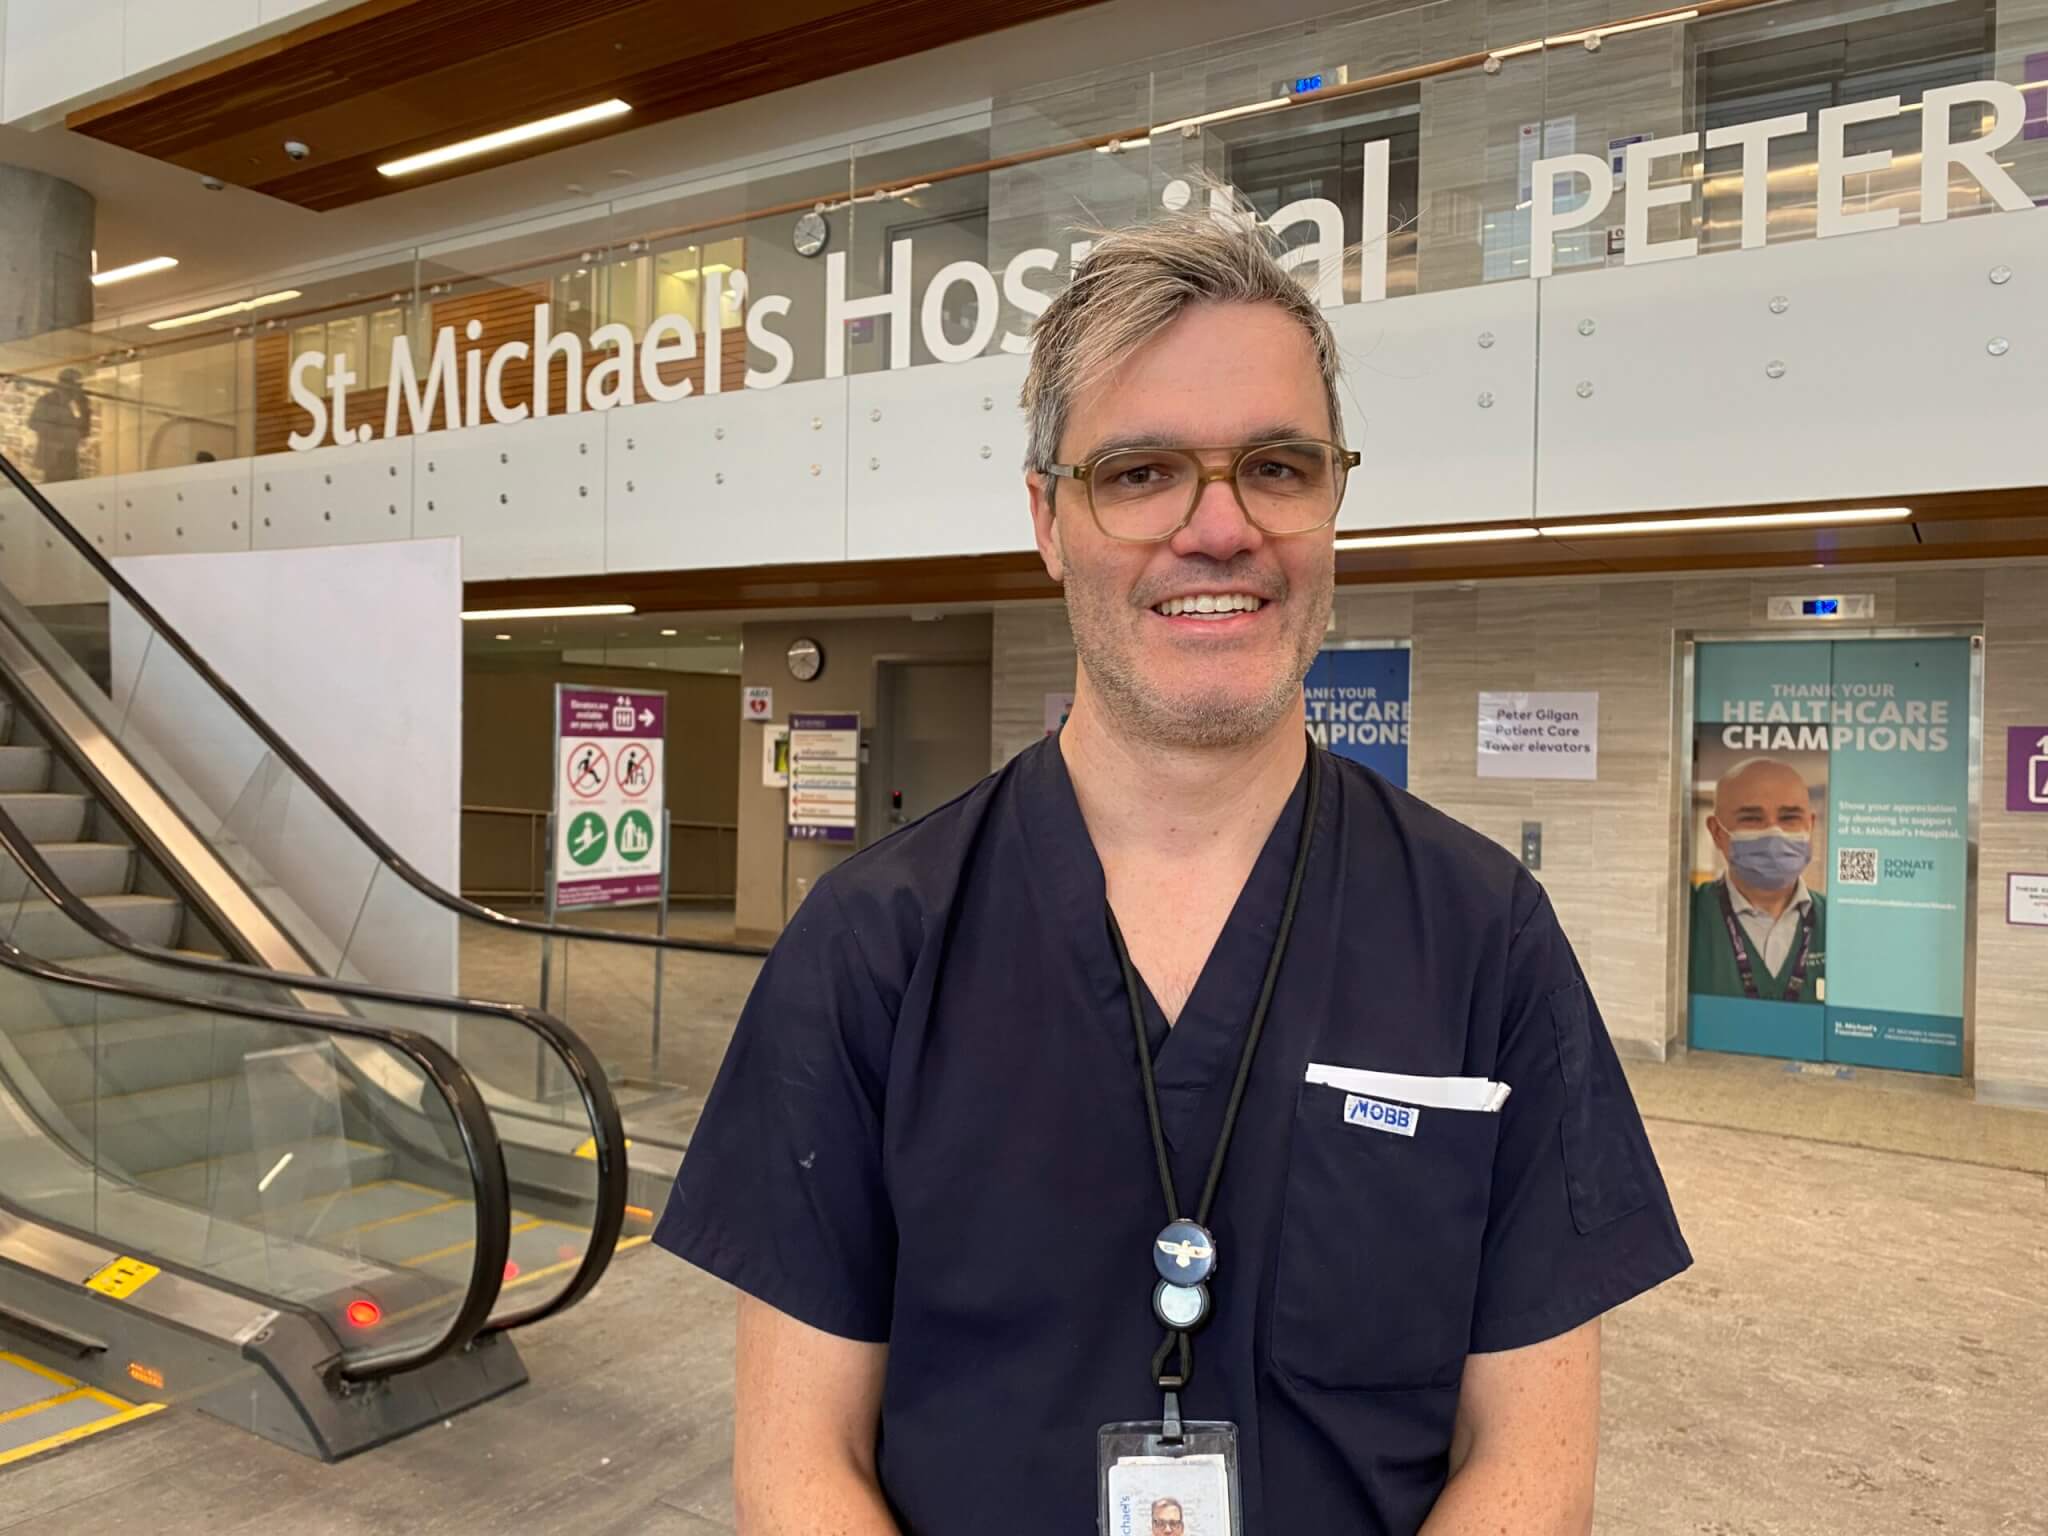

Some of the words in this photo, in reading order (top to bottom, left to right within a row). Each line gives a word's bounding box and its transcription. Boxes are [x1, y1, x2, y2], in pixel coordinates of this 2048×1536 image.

[288, 350, 371, 451] St.
[383, 269, 795, 438] Michael's
[825, 138, 1390, 379] Hosal
[1530, 80, 2036, 279] PETER
[1304, 687, 1335, 699] ANK
[1338, 687, 1377, 699] YOUR
[1771, 684, 1836, 697] THANK
[1841, 683, 1895, 698] YOUR
[1304, 701, 1410, 722] THCARE
[1496, 709, 1533, 721] Peter
[1536, 708, 1579, 723] Gilgan
[1722, 700, 1949, 724] HEALTHCARE
[1305, 723, 1410, 745] MPIONS
[1495, 724, 1545, 737] Patient
[1547, 725, 1580, 737] Care
[1722, 725, 1949, 752] CHAMPIONS
[1484, 740, 1525, 752] Tower
[1528, 741, 1591, 753] elevators
[1838, 800, 1866, 811] Show
[1868, 804, 1889, 813] your
[1838, 813, 1850, 824] by
[1884, 859, 1934, 871] DONATE
[1884, 869, 1916, 878] NOW
[1350, 1100, 1410, 1128] MOBB
[1119, 1495, 1132, 1536] chael's
